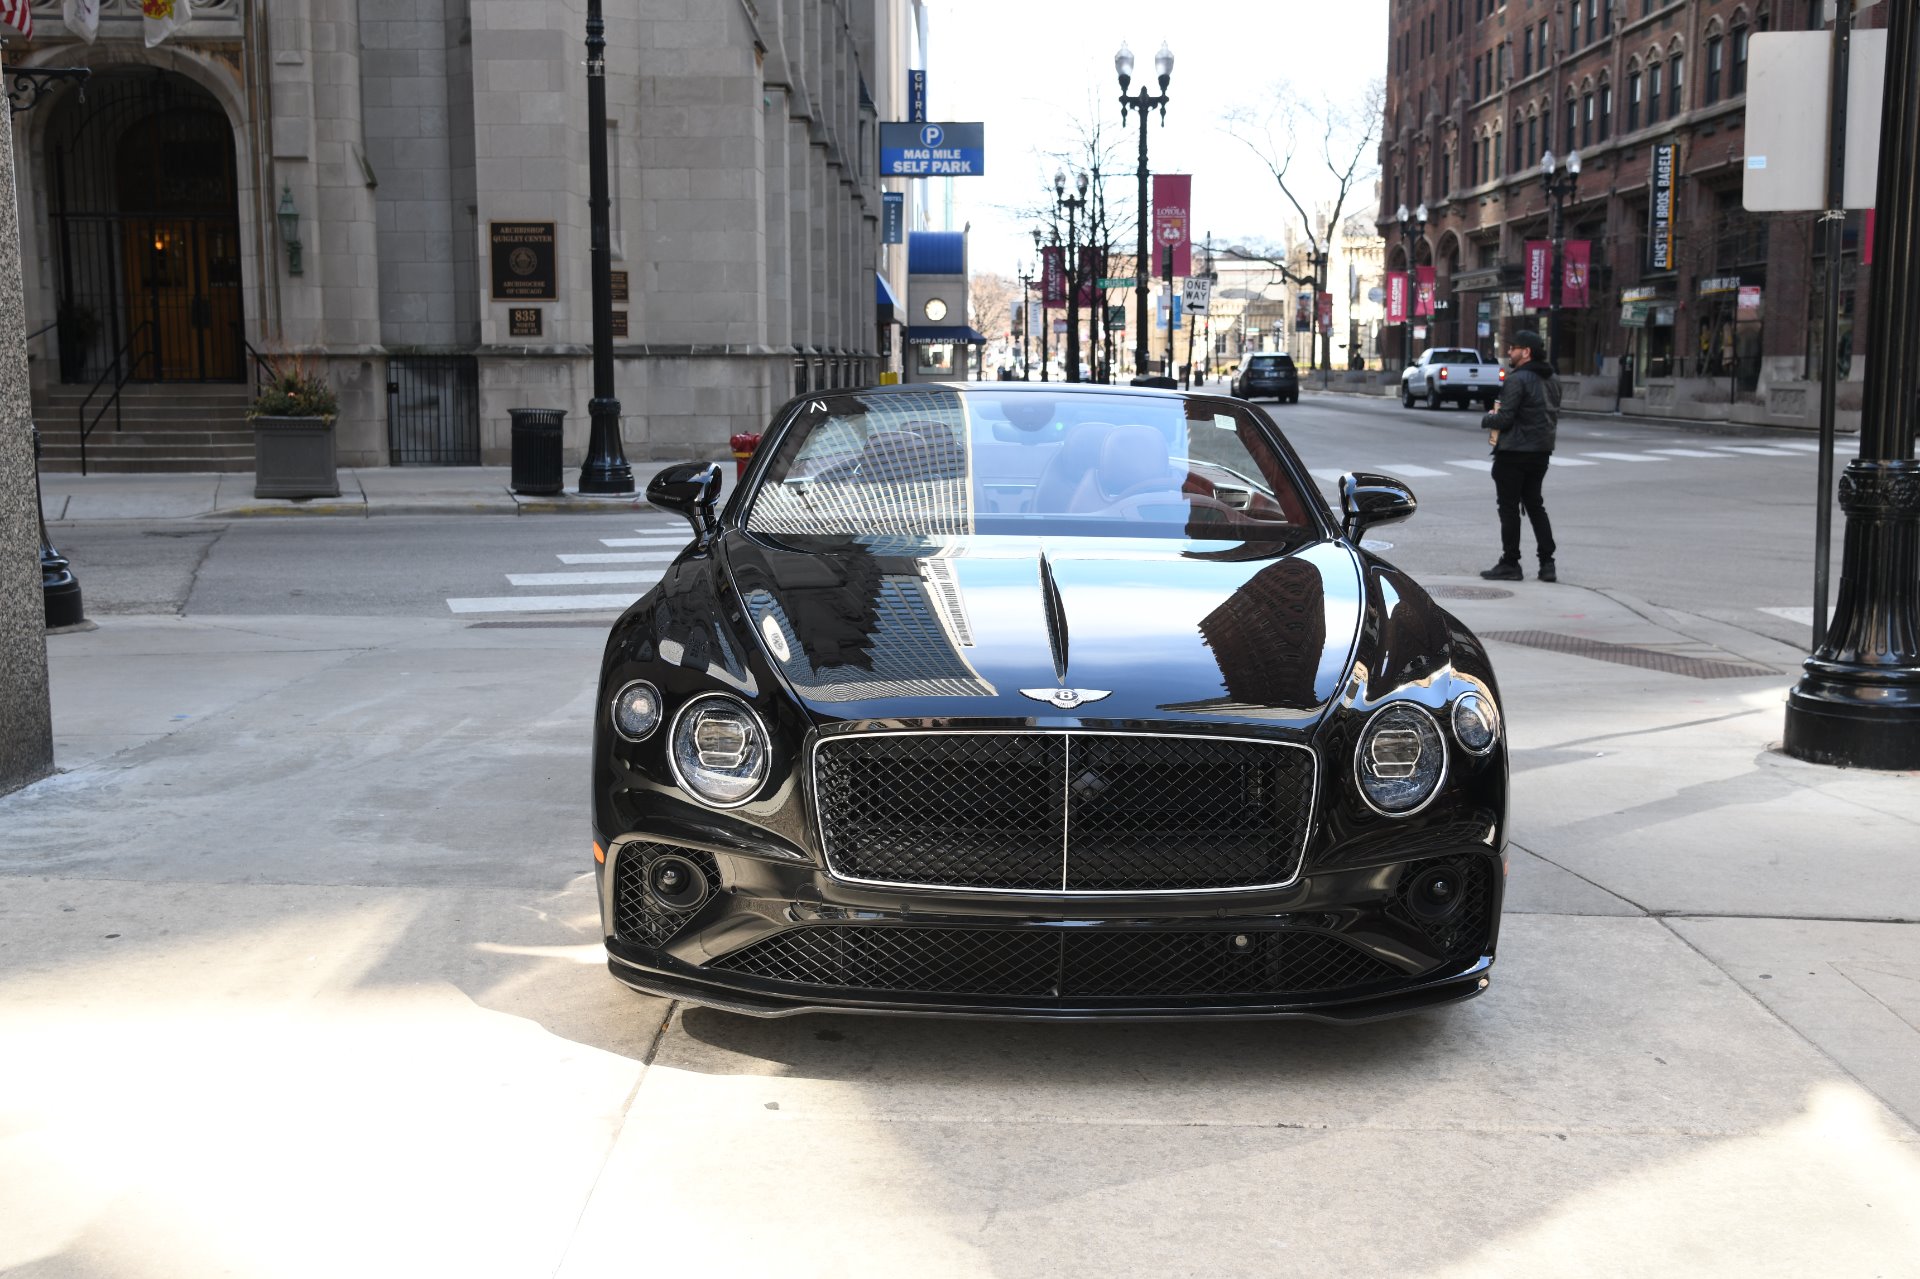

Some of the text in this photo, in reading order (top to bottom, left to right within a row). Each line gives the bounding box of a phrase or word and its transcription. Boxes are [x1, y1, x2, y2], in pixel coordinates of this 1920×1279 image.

[914, 72, 923, 122] GHIRA
[926, 128, 939, 144] P
[904, 149, 961, 159] MAG MILE
[893, 161, 971, 173] SELF PARK
[1657, 146, 1672, 187] BAGELS
[1156, 208, 1187, 216] LOYOLA
[500, 226, 545, 234] ARCHBISHOP
[493, 235, 552, 243] QUIGLEY CENTER
[1654, 220, 1668, 268] EINSTEIN
[1530, 249, 1540, 300] WELCOME
[1104, 280, 1126, 288] RUSH
[1186, 280, 1207, 291] ONE
[1186, 290, 1207, 300] WAY
[1391, 277, 1399, 316] WELCOME
[515, 310, 536, 321] 835
[909, 337, 968, 345] GHIRARDELLI
